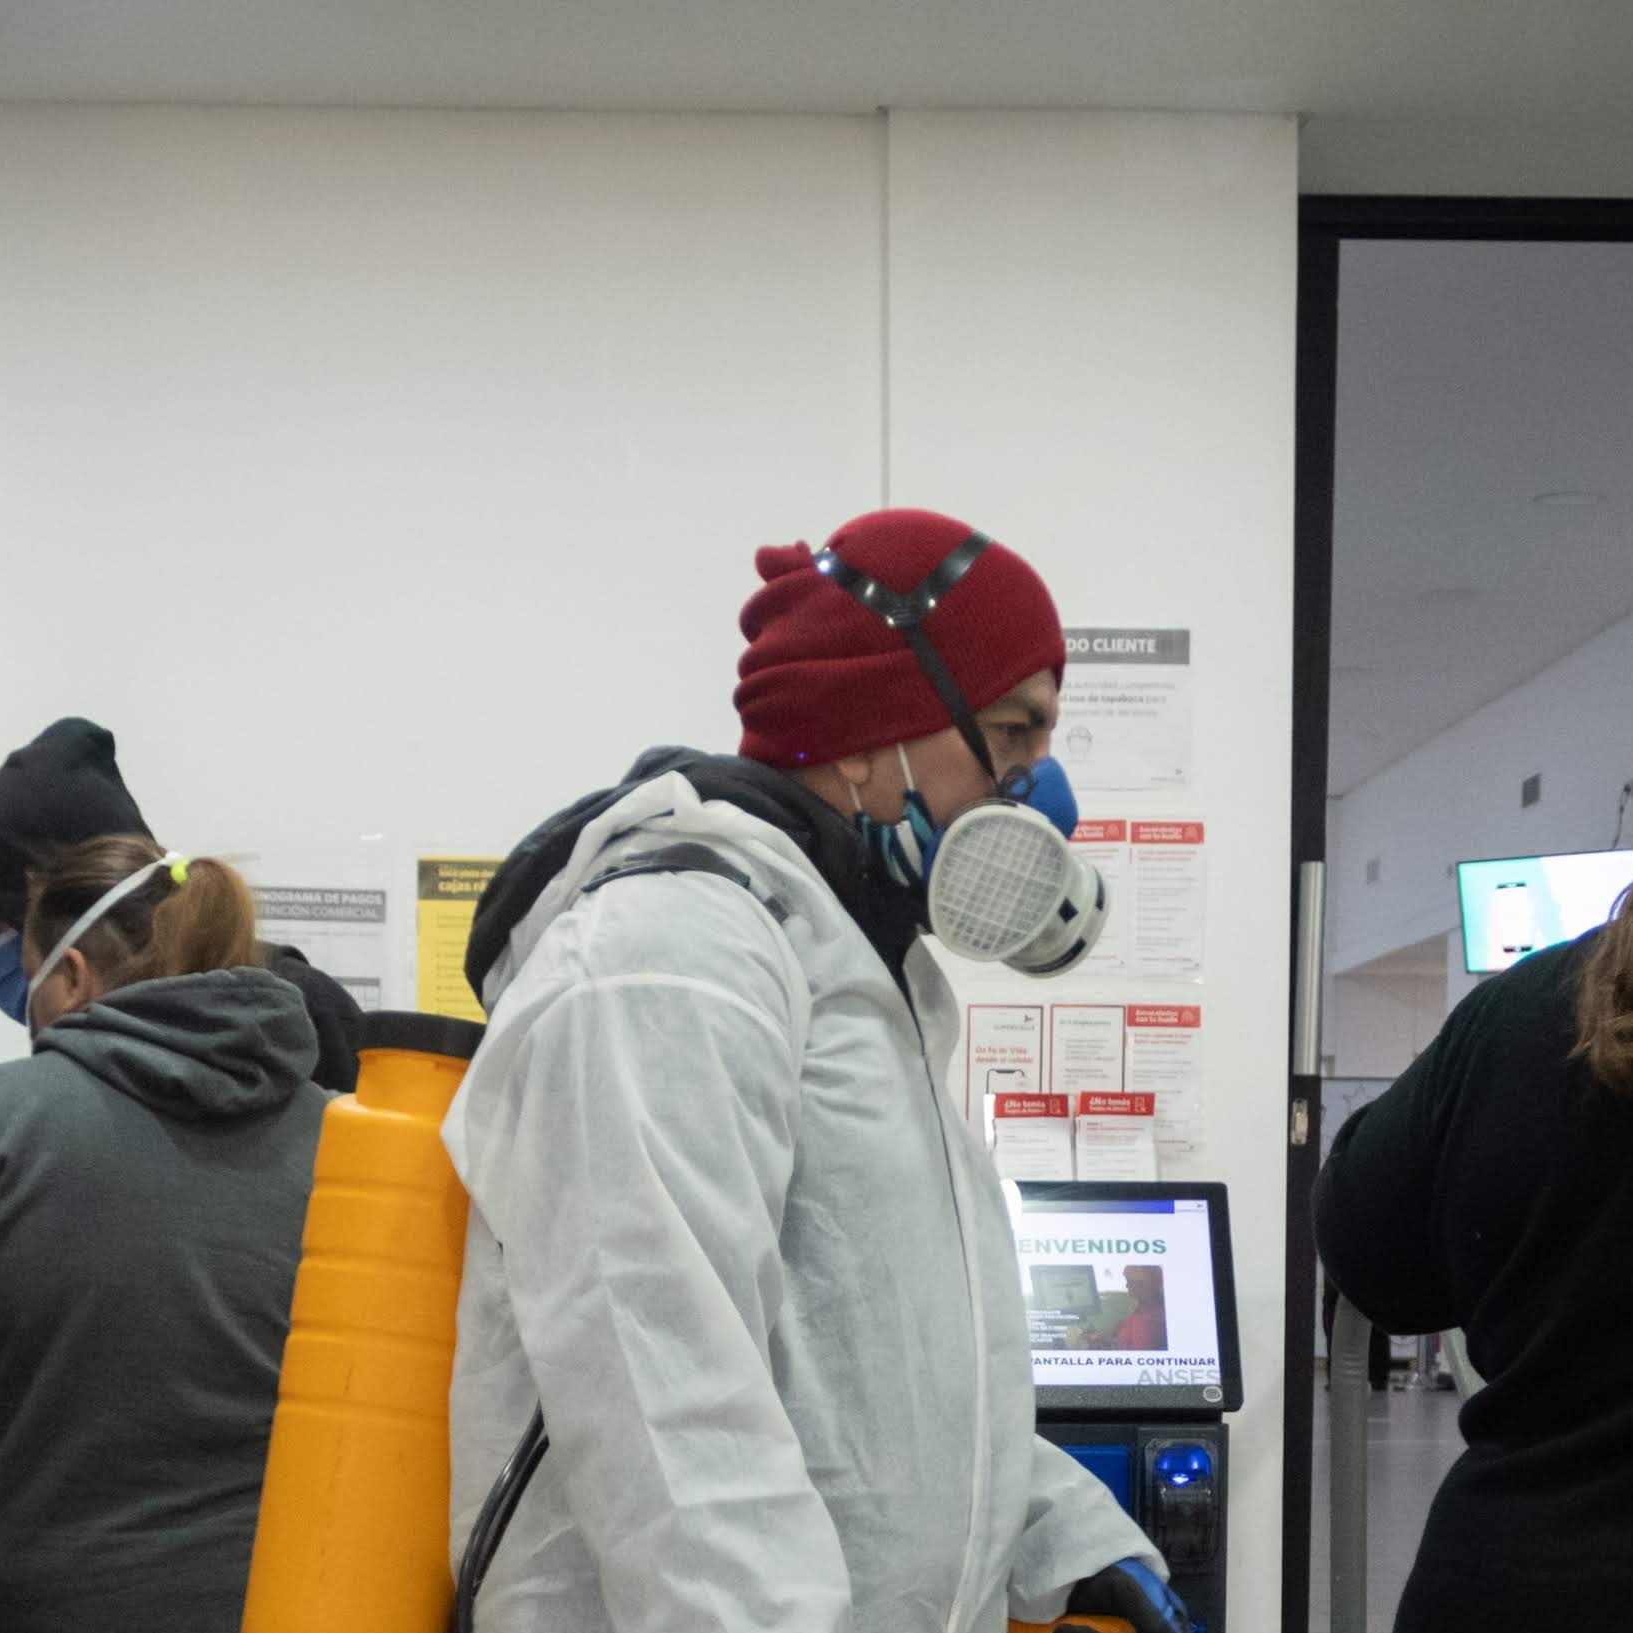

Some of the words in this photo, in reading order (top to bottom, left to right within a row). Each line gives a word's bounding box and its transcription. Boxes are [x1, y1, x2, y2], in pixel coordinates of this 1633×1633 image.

[1092, 637, 1157, 655] CLIENTE
[1018, 1239, 1167, 1255] ENVENIDOS
[1098, 1357, 1133, 1367] PARA
[1136, 1357, 1216, 1367] CONTINUAR
